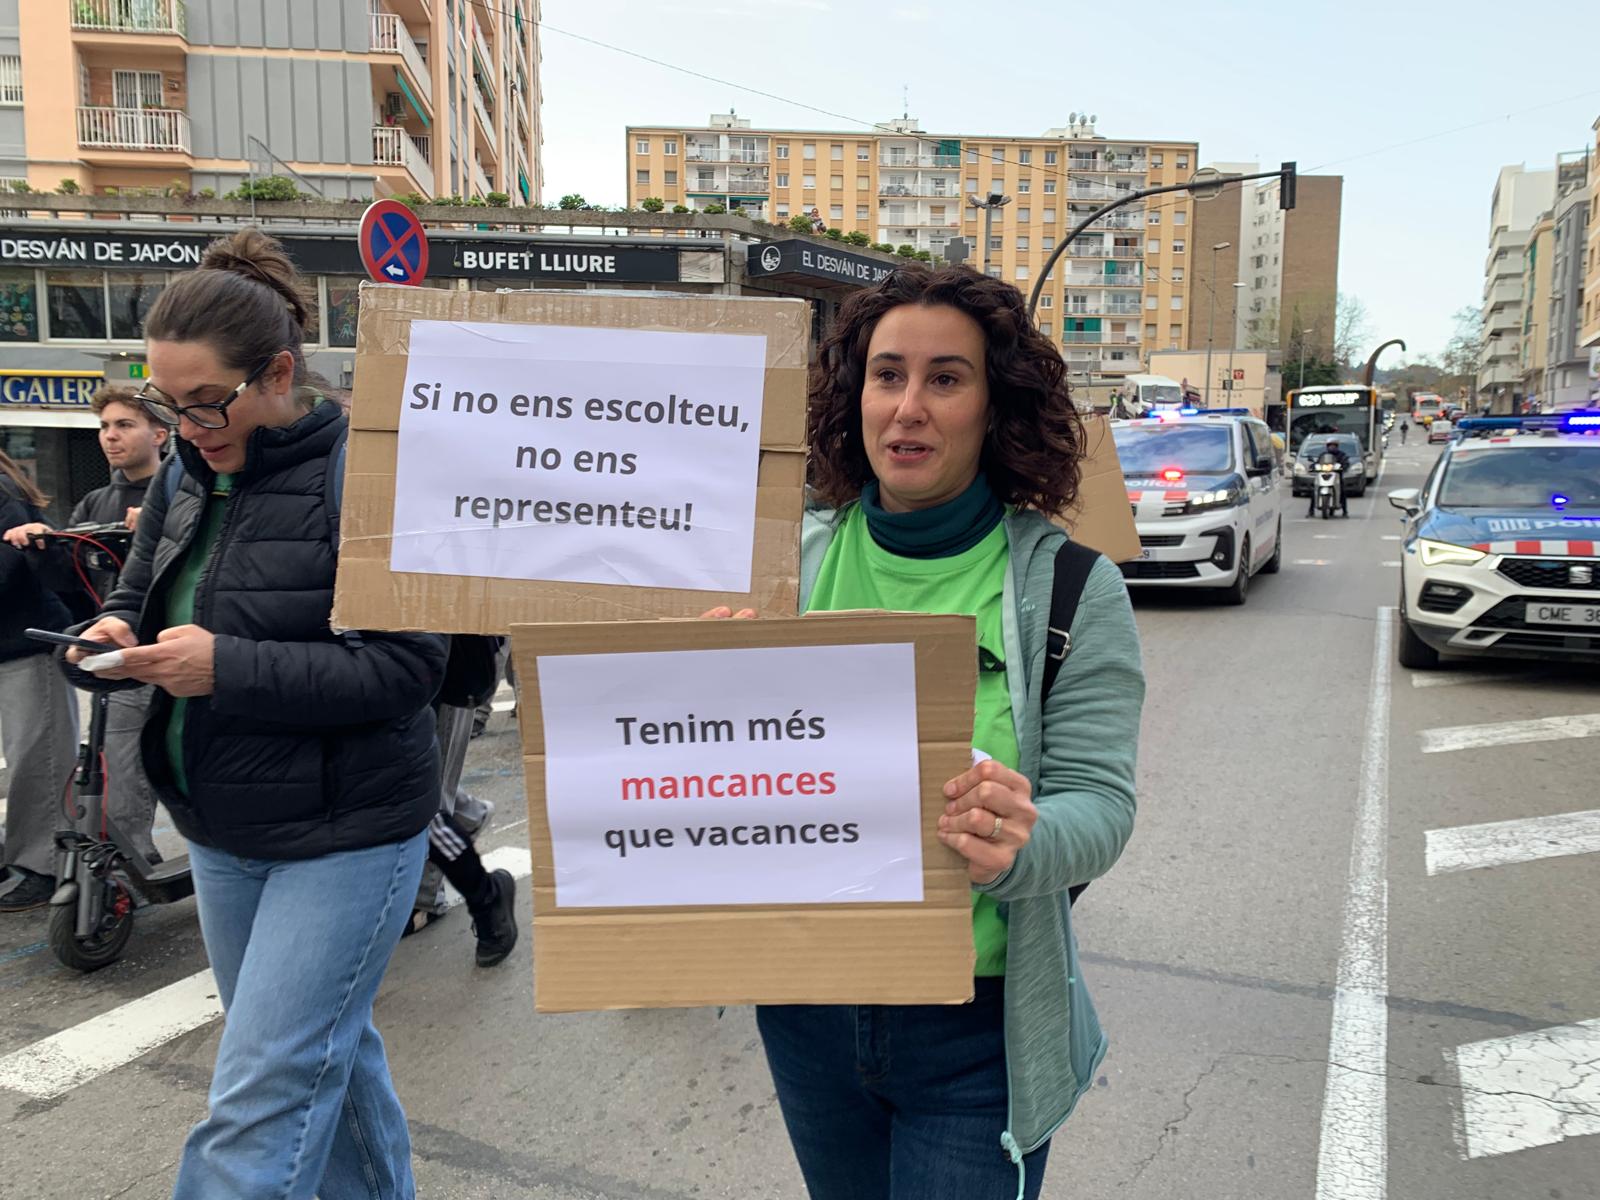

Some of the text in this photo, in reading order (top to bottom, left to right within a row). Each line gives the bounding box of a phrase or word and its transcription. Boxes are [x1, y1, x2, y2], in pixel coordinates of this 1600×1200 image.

[2, 237, 201, 263] DESVÁN DE JAPÓN
[462, 252, 617, 273] BUFET LLIURE
[802, 250, 815, 268] EL
[817, 253, 855, 276] DESVÁN
[857, 263, 870, 281] DE
[410, 382, 750, 433] Si no ens escolteu,
[516, 446, 638, 476] no ens
[1124, 479, 1188, 488] olicia
[454, 494, 693, 532] representeu!
[1537, 607, 1572, 622] CME
[615, 709, 826, 746] Tenim més
[621, 770, 837, 801] mancances
[604, 821, 860, 858] que vacances
